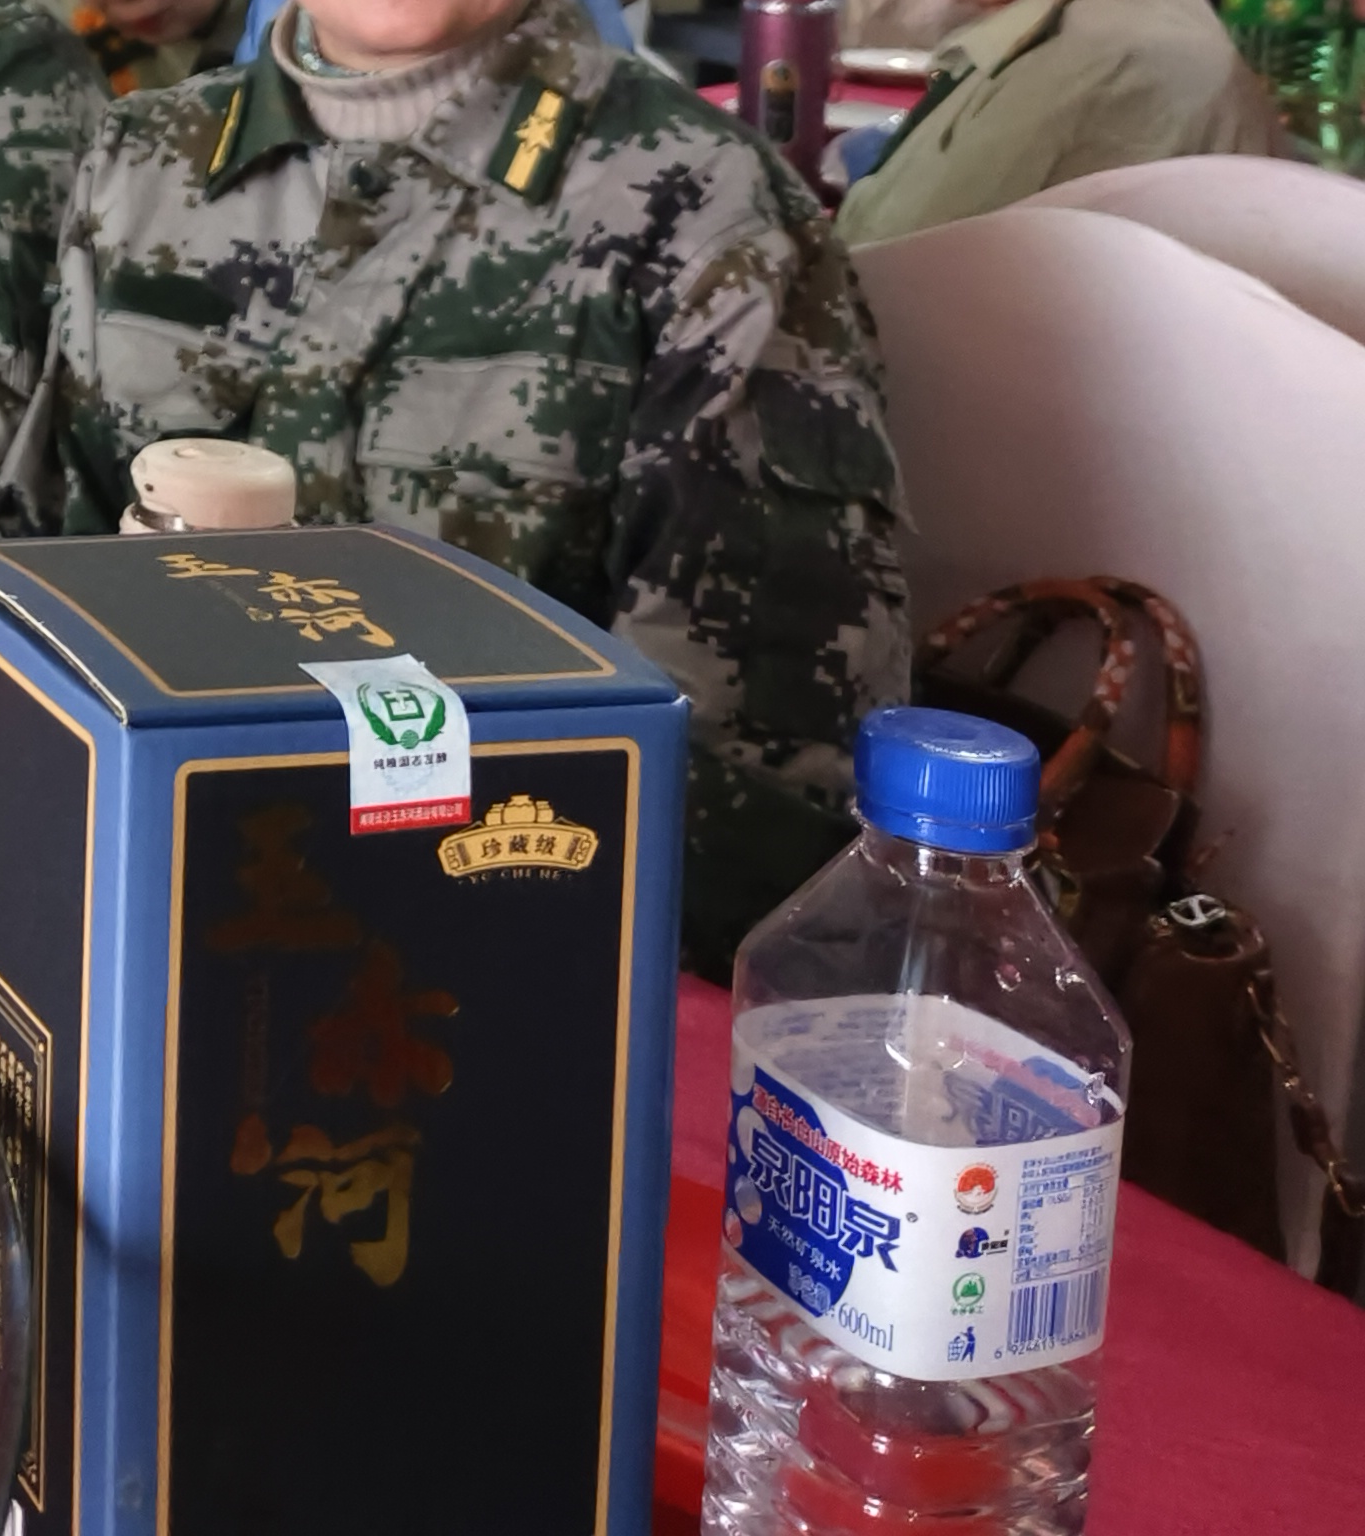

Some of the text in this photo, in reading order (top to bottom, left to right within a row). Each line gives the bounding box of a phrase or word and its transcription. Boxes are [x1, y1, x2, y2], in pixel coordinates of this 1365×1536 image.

[480, 833, 558, 859] 珍藏级
[747, 1127, 901, 1273] 泉阳泉
[767, 1214, 842, 1282] 天然矿泉水
